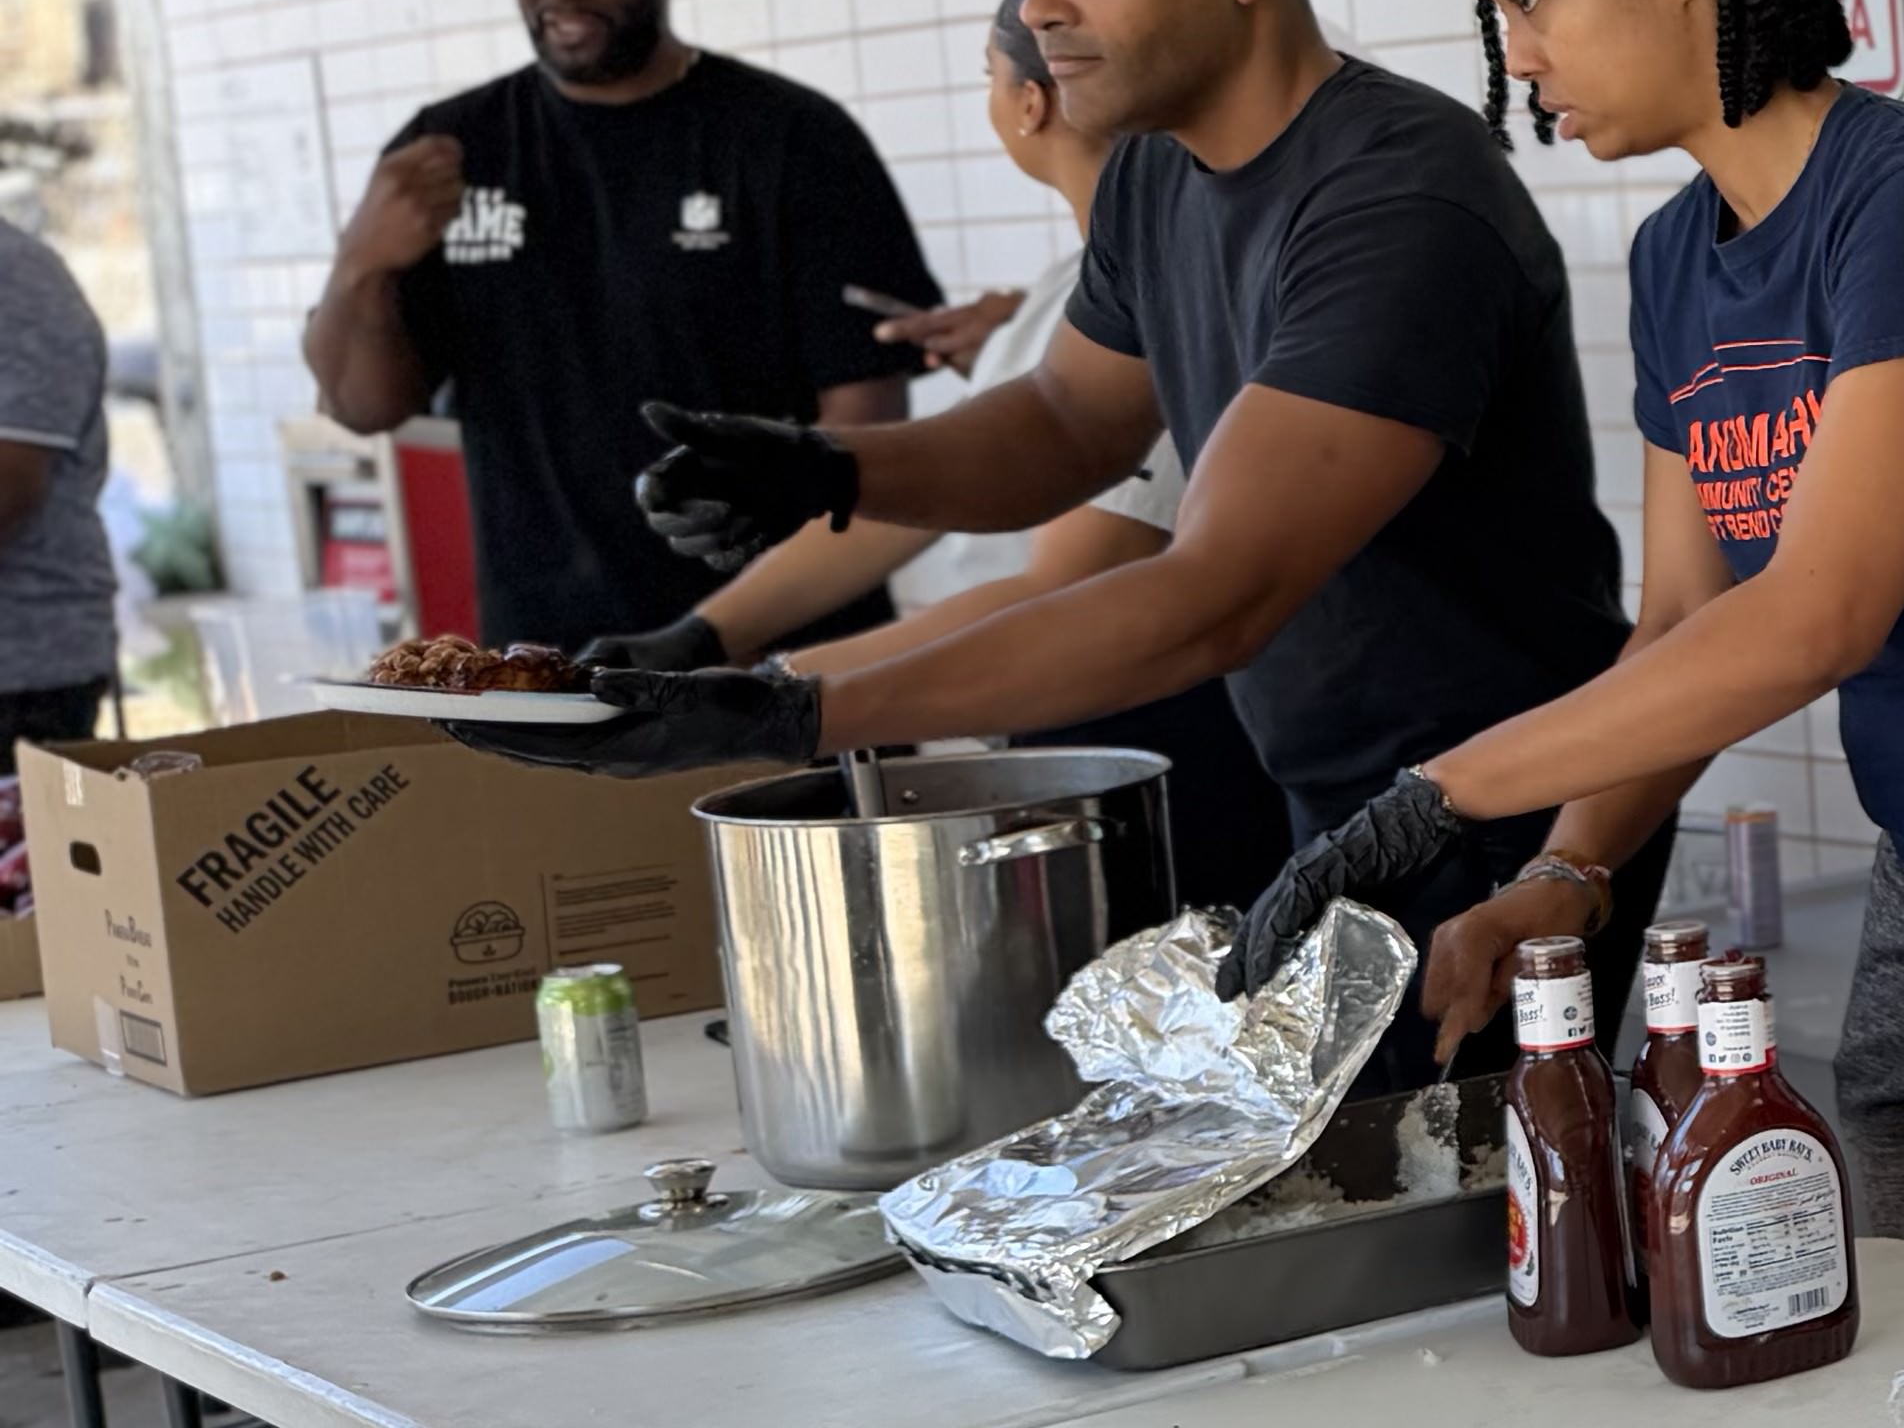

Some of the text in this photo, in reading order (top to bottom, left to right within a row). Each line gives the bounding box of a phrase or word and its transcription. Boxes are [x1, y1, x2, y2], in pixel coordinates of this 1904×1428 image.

[443, 204, 526, 250] AME
[1687, 389, 1822, 473] ANDMAR
[176, 765, 342, 909] FRAGILE
[216, 764, 411, 934] HANDLE WITH CARE
[1730, 1147, 1761, 1176] SWEET
[1761, 1139, 1787, 1154] BABY
[1750, 1169, 1797, 1186] ORIGINAL
